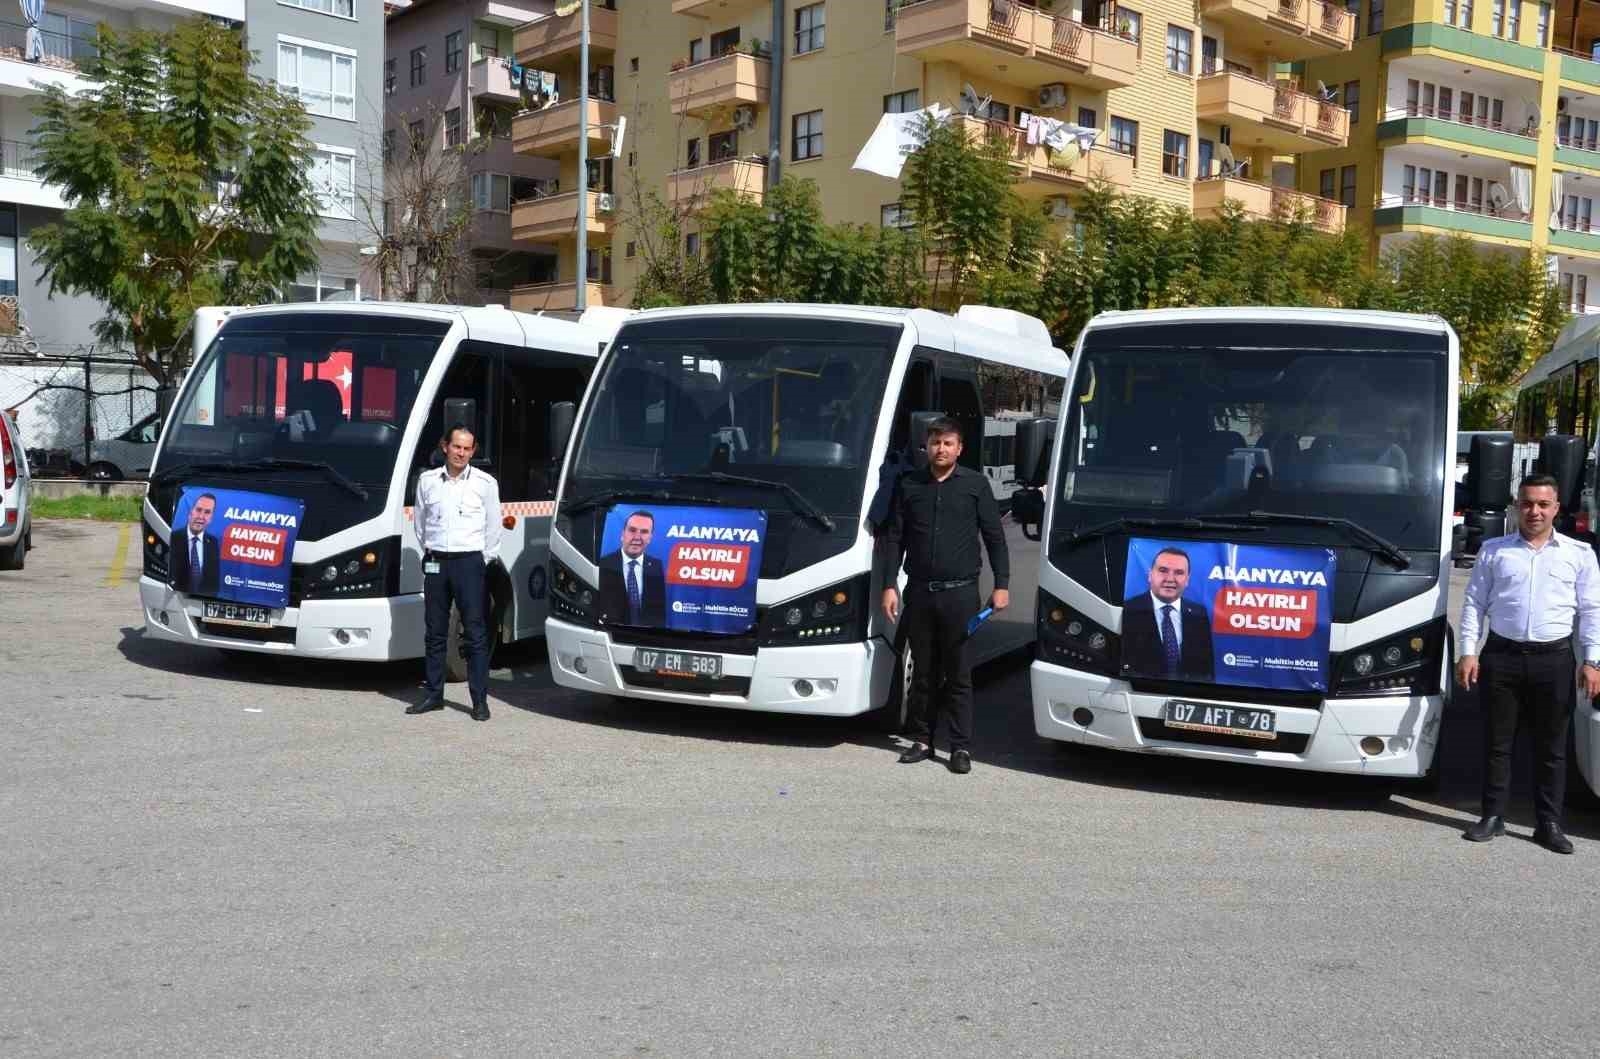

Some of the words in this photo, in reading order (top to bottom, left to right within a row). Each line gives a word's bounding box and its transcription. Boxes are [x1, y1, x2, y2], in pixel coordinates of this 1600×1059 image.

[224, 507, 297, 528] ALANYA'YA
[230, 527, 281, 544] HAYIRLI
[666, 525, 760, 543] ALANYA'YA
[230, 545, 275, 561] OLSUN
[678, 547, 742, 563] HAYIRLI
[679, 566, 736, 582] OLSUN
[1208, 565, 1327, 587] ALANYA'YA
[1226, 591, 1308, 610] HAYIRLI
[207, 603, 219, 617] 07
[246, 607, 265, 622] 075
[1229, 613, 1301, 632] OLSUN
[642, 651, 658, 668] 07
[692, 656, 716, 673] 583
[1175, 703, 1196, 722] 07
[1203, 707, 1235, 726] AFT
[1249, 711, 1271, 731] 78
